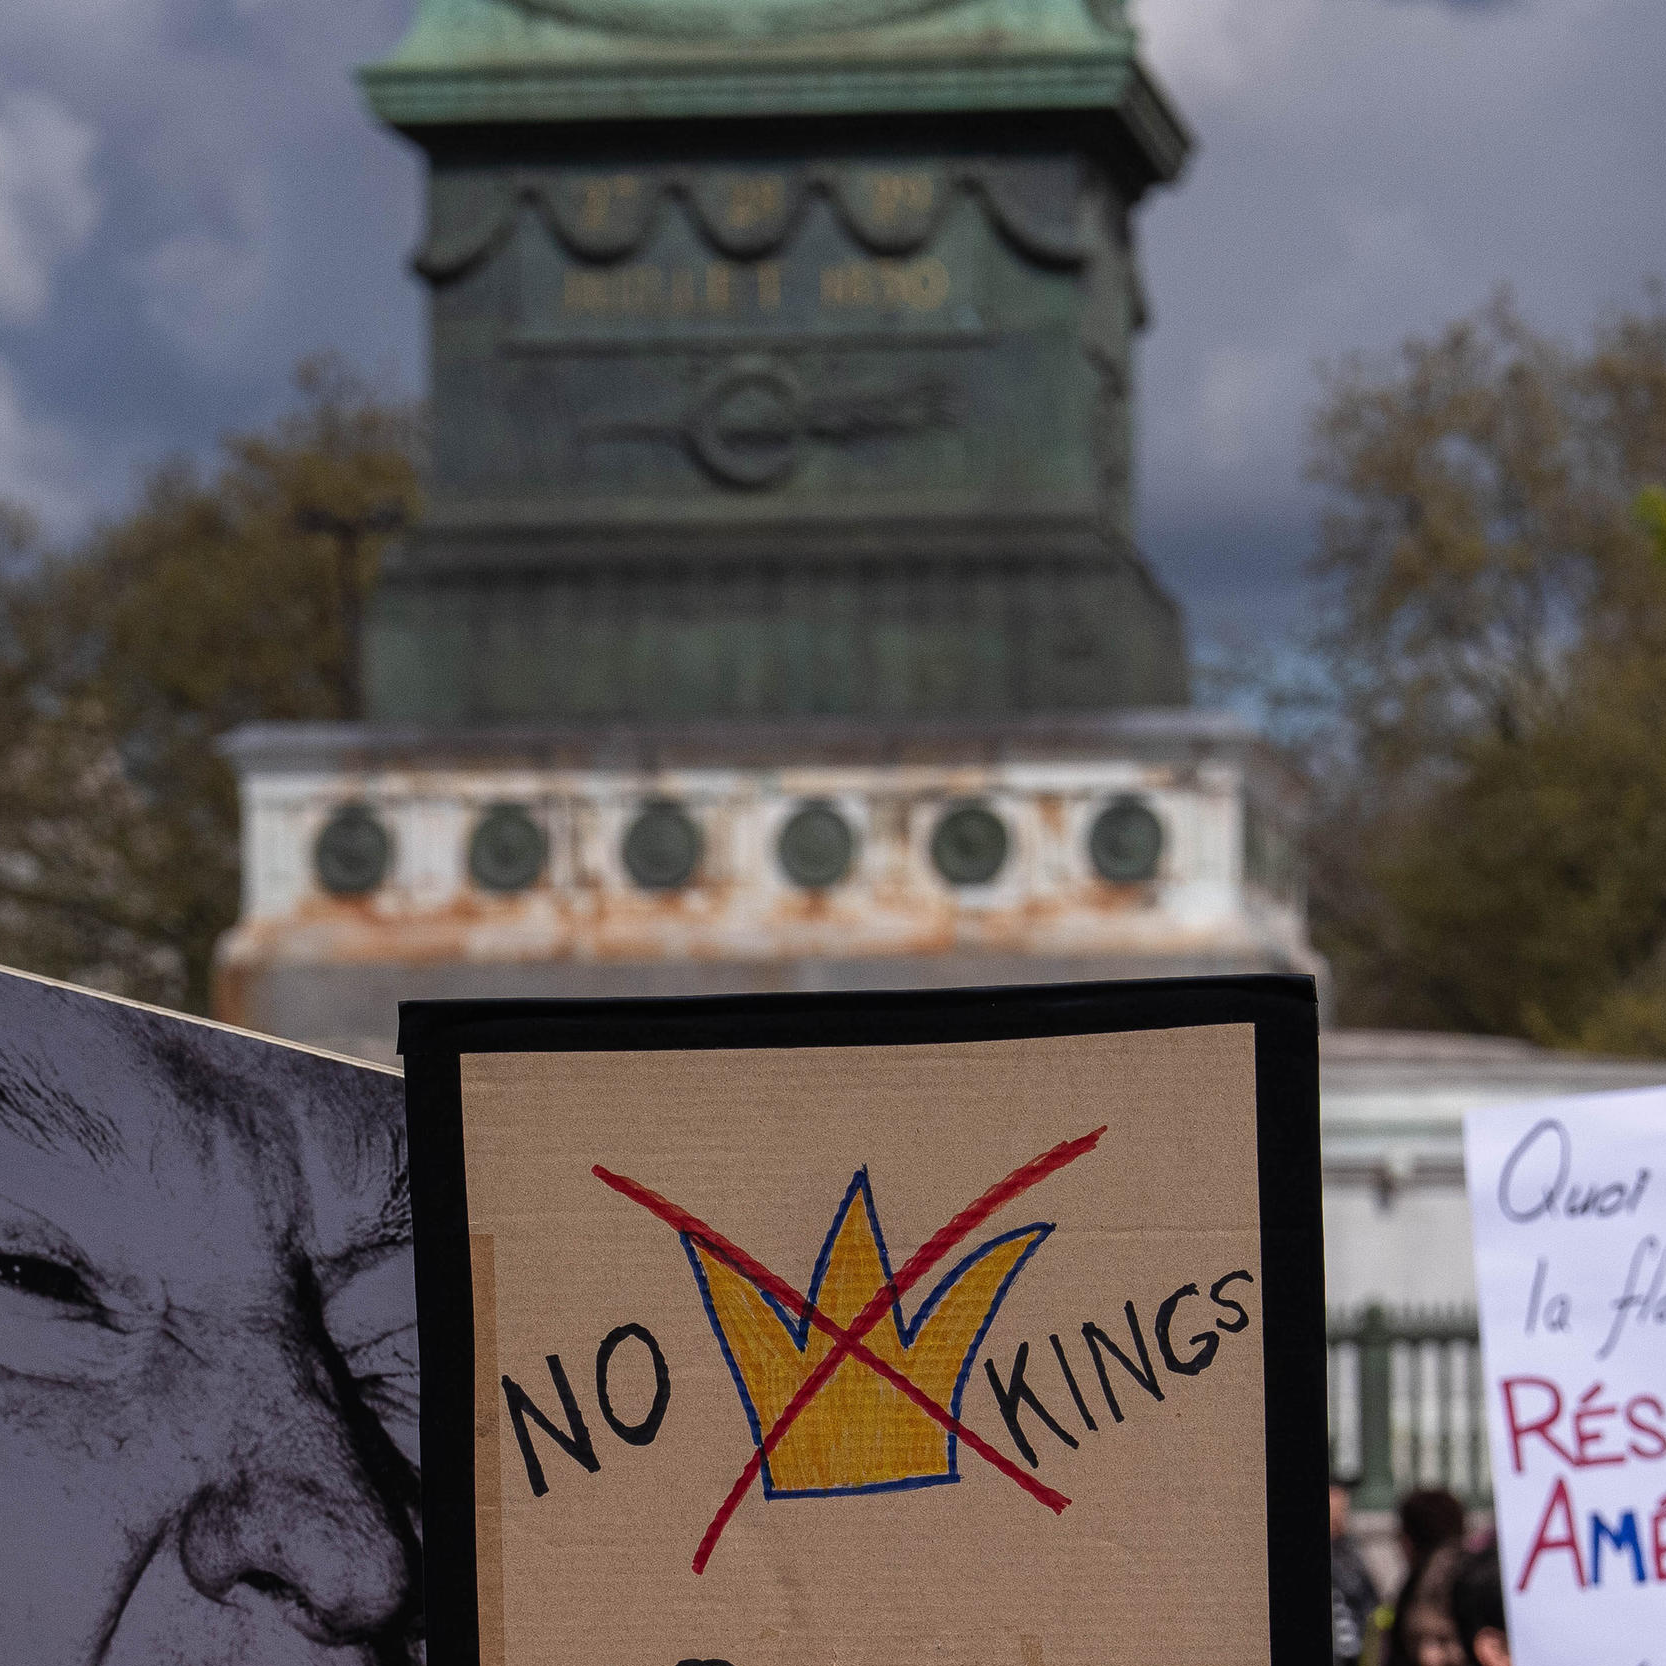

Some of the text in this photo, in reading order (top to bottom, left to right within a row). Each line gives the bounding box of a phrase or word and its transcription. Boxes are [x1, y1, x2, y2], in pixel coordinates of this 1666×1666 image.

[1524, 1255, 1573, 1336] la
[501, 1269, 1254, 1497] NO KINGS
